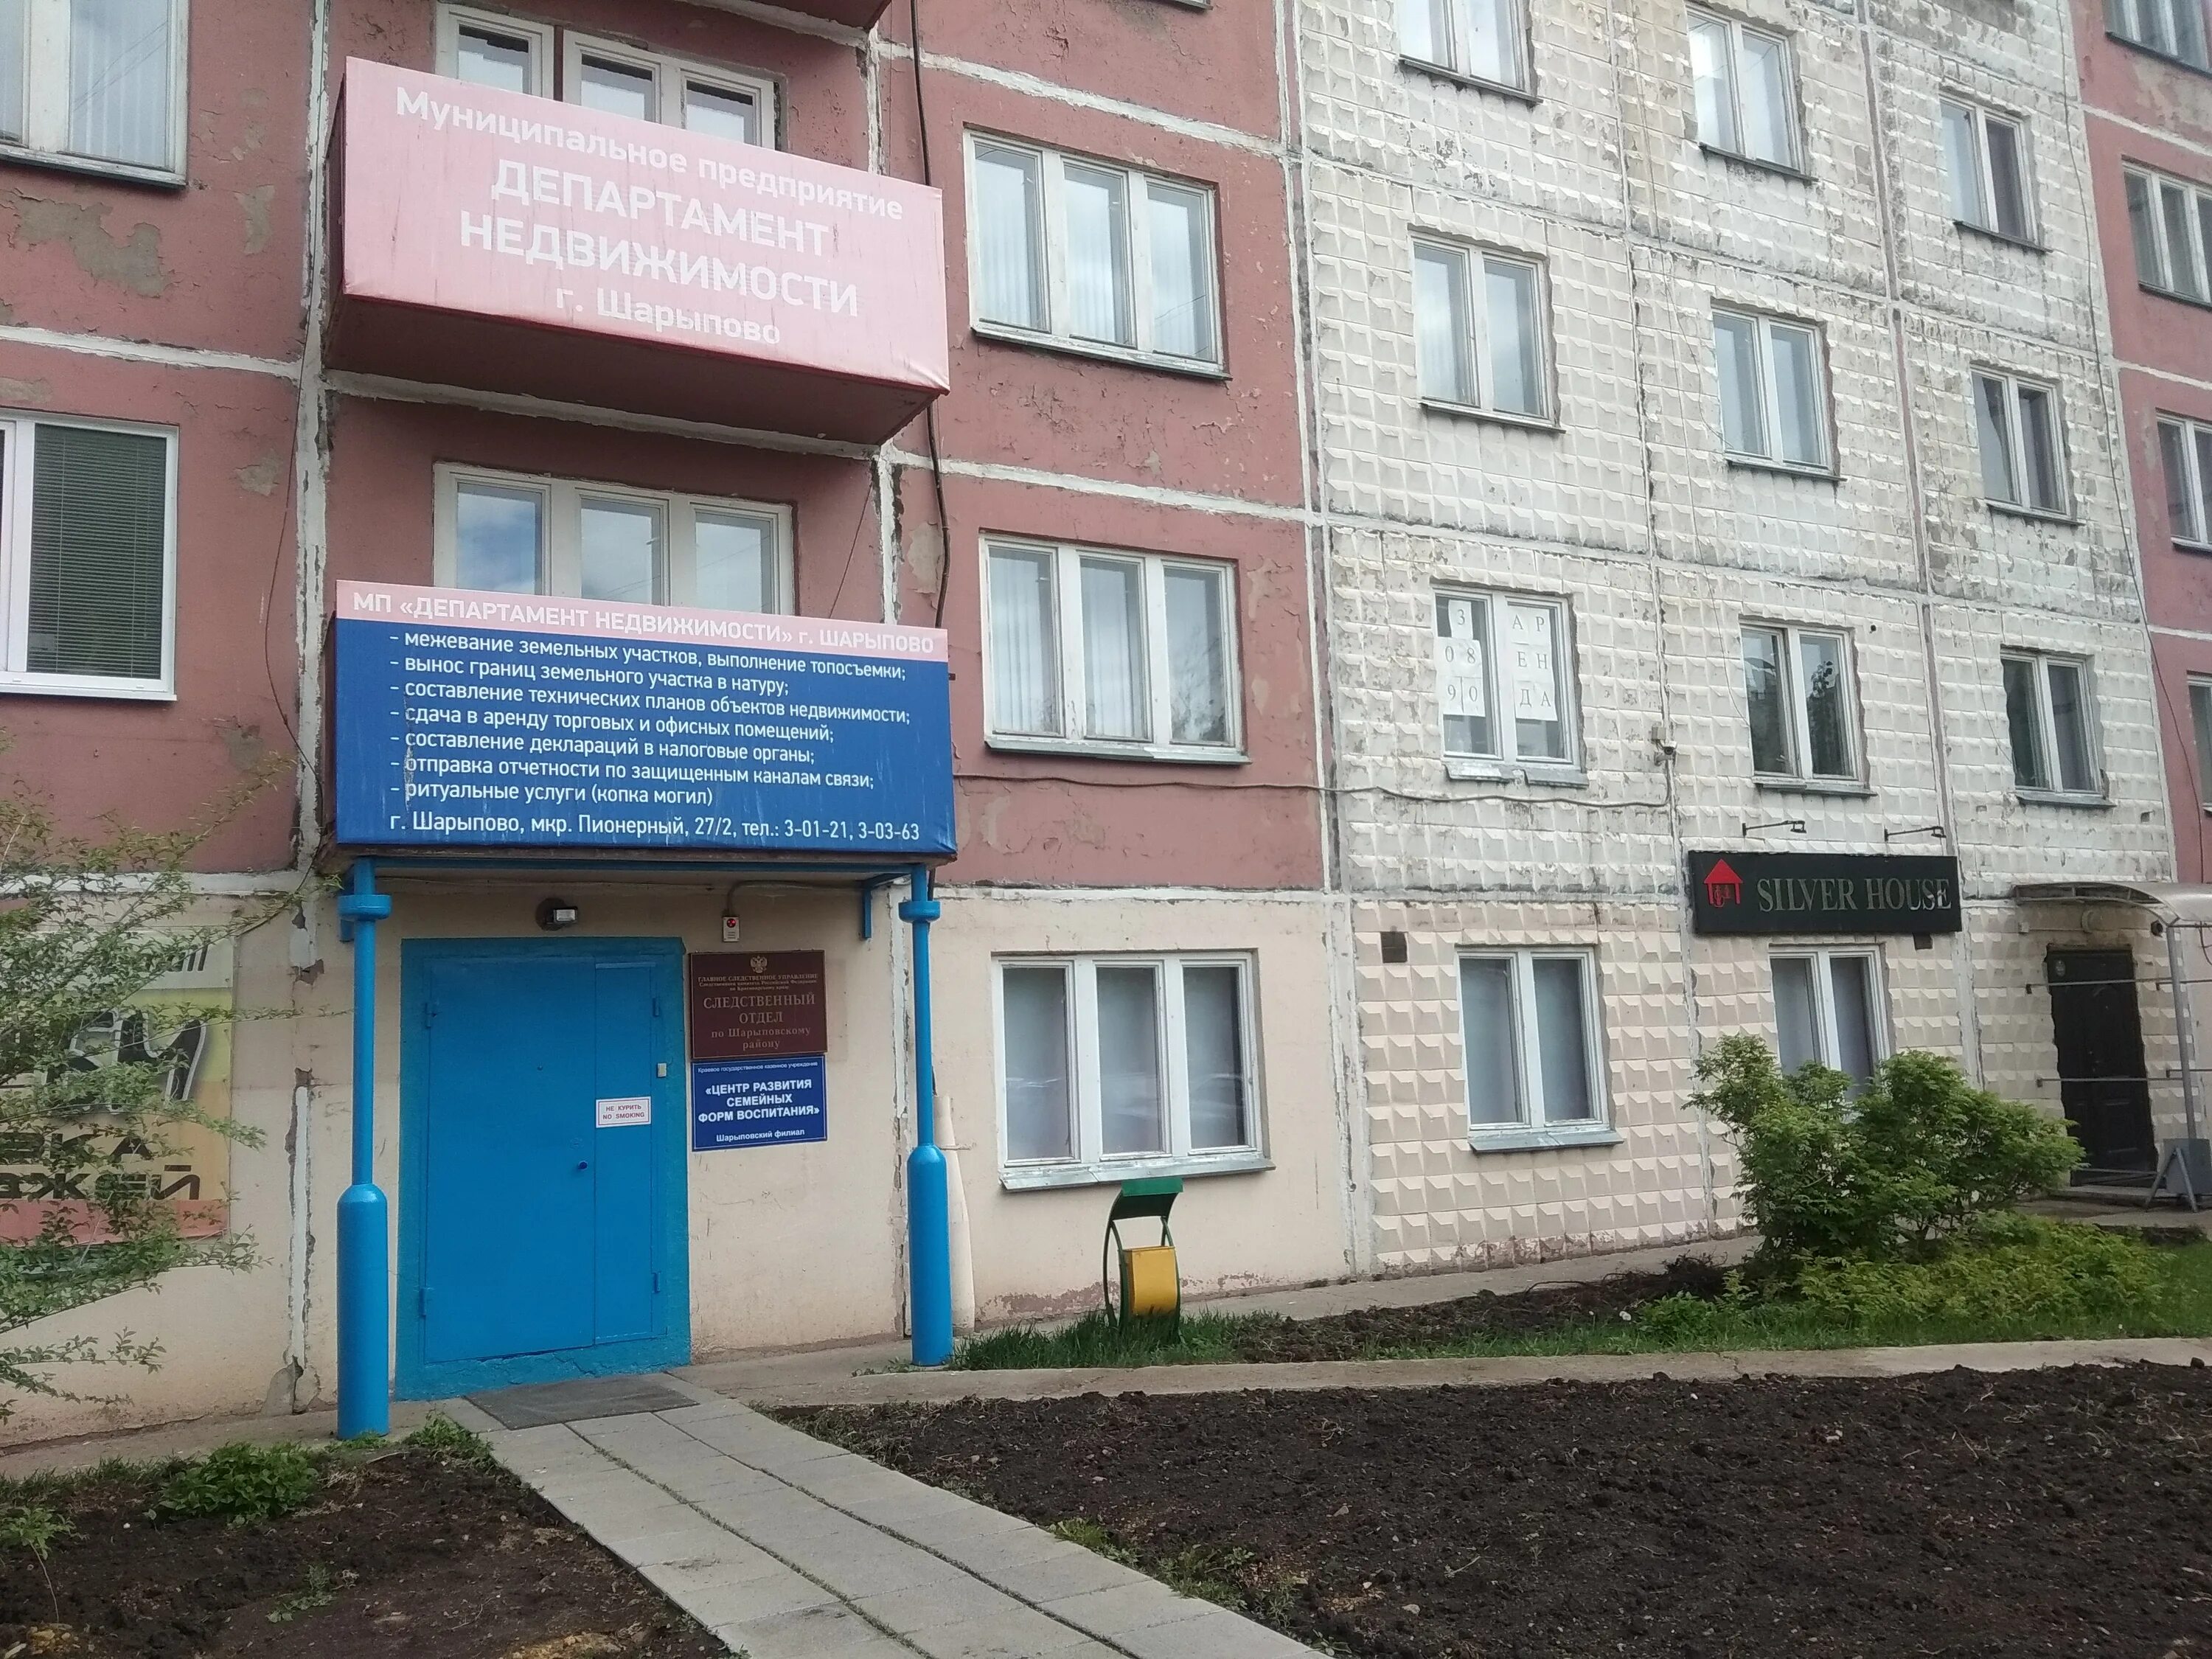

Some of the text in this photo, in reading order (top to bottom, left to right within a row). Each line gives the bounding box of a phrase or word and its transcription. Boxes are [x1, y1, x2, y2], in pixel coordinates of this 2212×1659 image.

[396, 86, 904, 221] Муниципальное предприятие
[492, 159, 831, 257] ДЕПАРТАМЕНТ
[459, 210, 858, 317] НЕДВИЖИМОСТИ
[557, 288, 782, 345] г. Шарыпово
[353, 591, 935, 654] МП «ДЕПАРТАМЕНТ НЕДВИЖИМОСТИ» г. ШАРЫПОВО
[1457, 608, 1466, 625] 3
[406, 633, 514, 653] межевание
[519, 640, 619, 660] земельных
[622, 647, 702, 667] участков,
[708, 653, 807, 672] выполнение
[810, 660, 906, 681] топосъемки;
[406, 657, 465, 674] вынос
[470, 661, 536, 681] границ
[540, 667, 644, 684] земельного
[649, 672, 713, 689] участка
[717, 677, 727, 689] в
[731, 678, 789, 698] натуру;
[406, 682, 524, 702] составление
[529, 689, 641, 708] технических
[646, 695, 706, 712] планов
[711, 695, 785, 716] объектов
[790, 704, 910, 725] недвижимости;
[406, 707, 462, 725] сдача
[467, 710, 478, 724] в
[484, 711, 549, 731] аренду
[553, 714, 635, 733] торговых
[639, 719, 650, 731] и
[655, 716, 730, 737] офисных
[734, 723, 834, 743] помещений;
[406, 732, 524, 751] составление
[529, 737, 639, 757] деклараций
[644, 742, 654, 755] в
[659, 743, 748, 759] налоговые
[753, 748, 815, 765] органы;
[406, 758, 493, 777] отправка
[498, 761, 599, 777] отчетности
[605, 765, 626, 779] по
[631, 765, 749, 783] защищенным
[754, 771, 821, 785] каналам
[825, 773, 874, 790] связи;
[406, 783, 520, 802] ритуальные
[524, 786, 585, 805] услуги
[591, 783, 649, 804] (копка
[654, 787, 713, 807] могил)
[390, 811, 920, 841] г. Шарыпово, мкр. Пионерный, 27/2, тел.: 3-01-21, 3-03-63
[1756, 877, 1952, 912] SILVER HOUSE
[703, 992, 815, 1009] СЛЕДСТВЕННЫЙ
[728, 1027, 811, 1040] Шарыповскому
[739, 1012, 784, 1024] ОТДЕЛ
[742, 1039, 780, 1051] району
[705, 1079, 812, 1096] «ЦЕНТР РАЗВИТИЯ
[726, 1093, 793, 1107] СЕМЕЙНЫХ
[698, 1105, 820, 1124] ФОРМ ВОСПИТАНИЯ»
[716, 1128, 805, 1142] Шарыповский филиал
